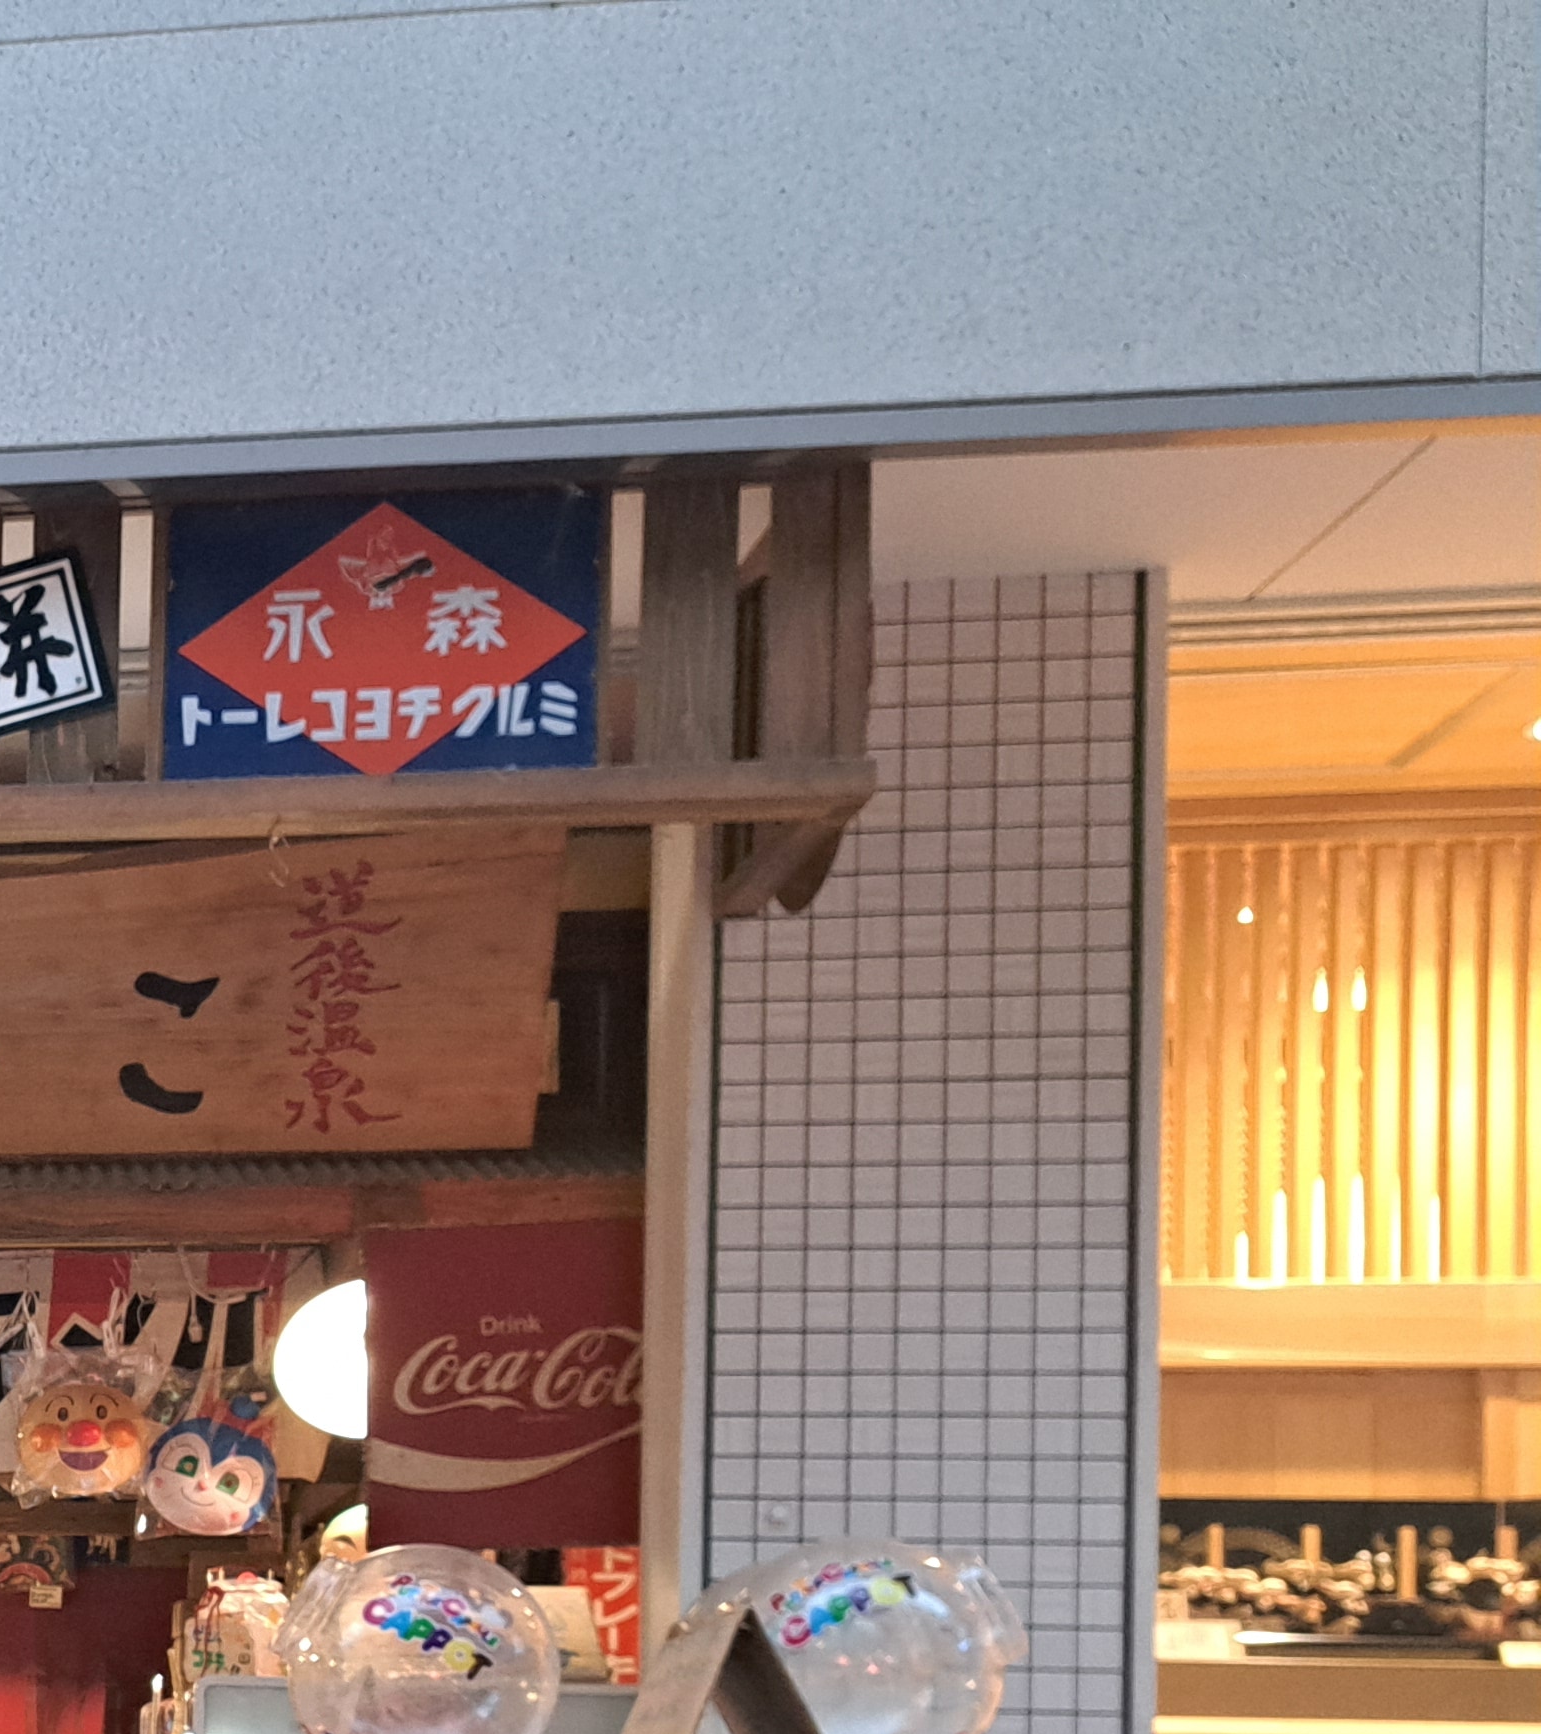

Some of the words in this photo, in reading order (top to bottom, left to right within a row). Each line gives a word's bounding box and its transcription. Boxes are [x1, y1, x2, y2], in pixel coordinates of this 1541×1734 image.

[283, 858, 404, 1135] 道後温泉
[480, 1315, 544, 1336] Drink
[393, 1324, 642, 1416] Coca-Col
[362, 1597, 494, 1681] CAPPOT
